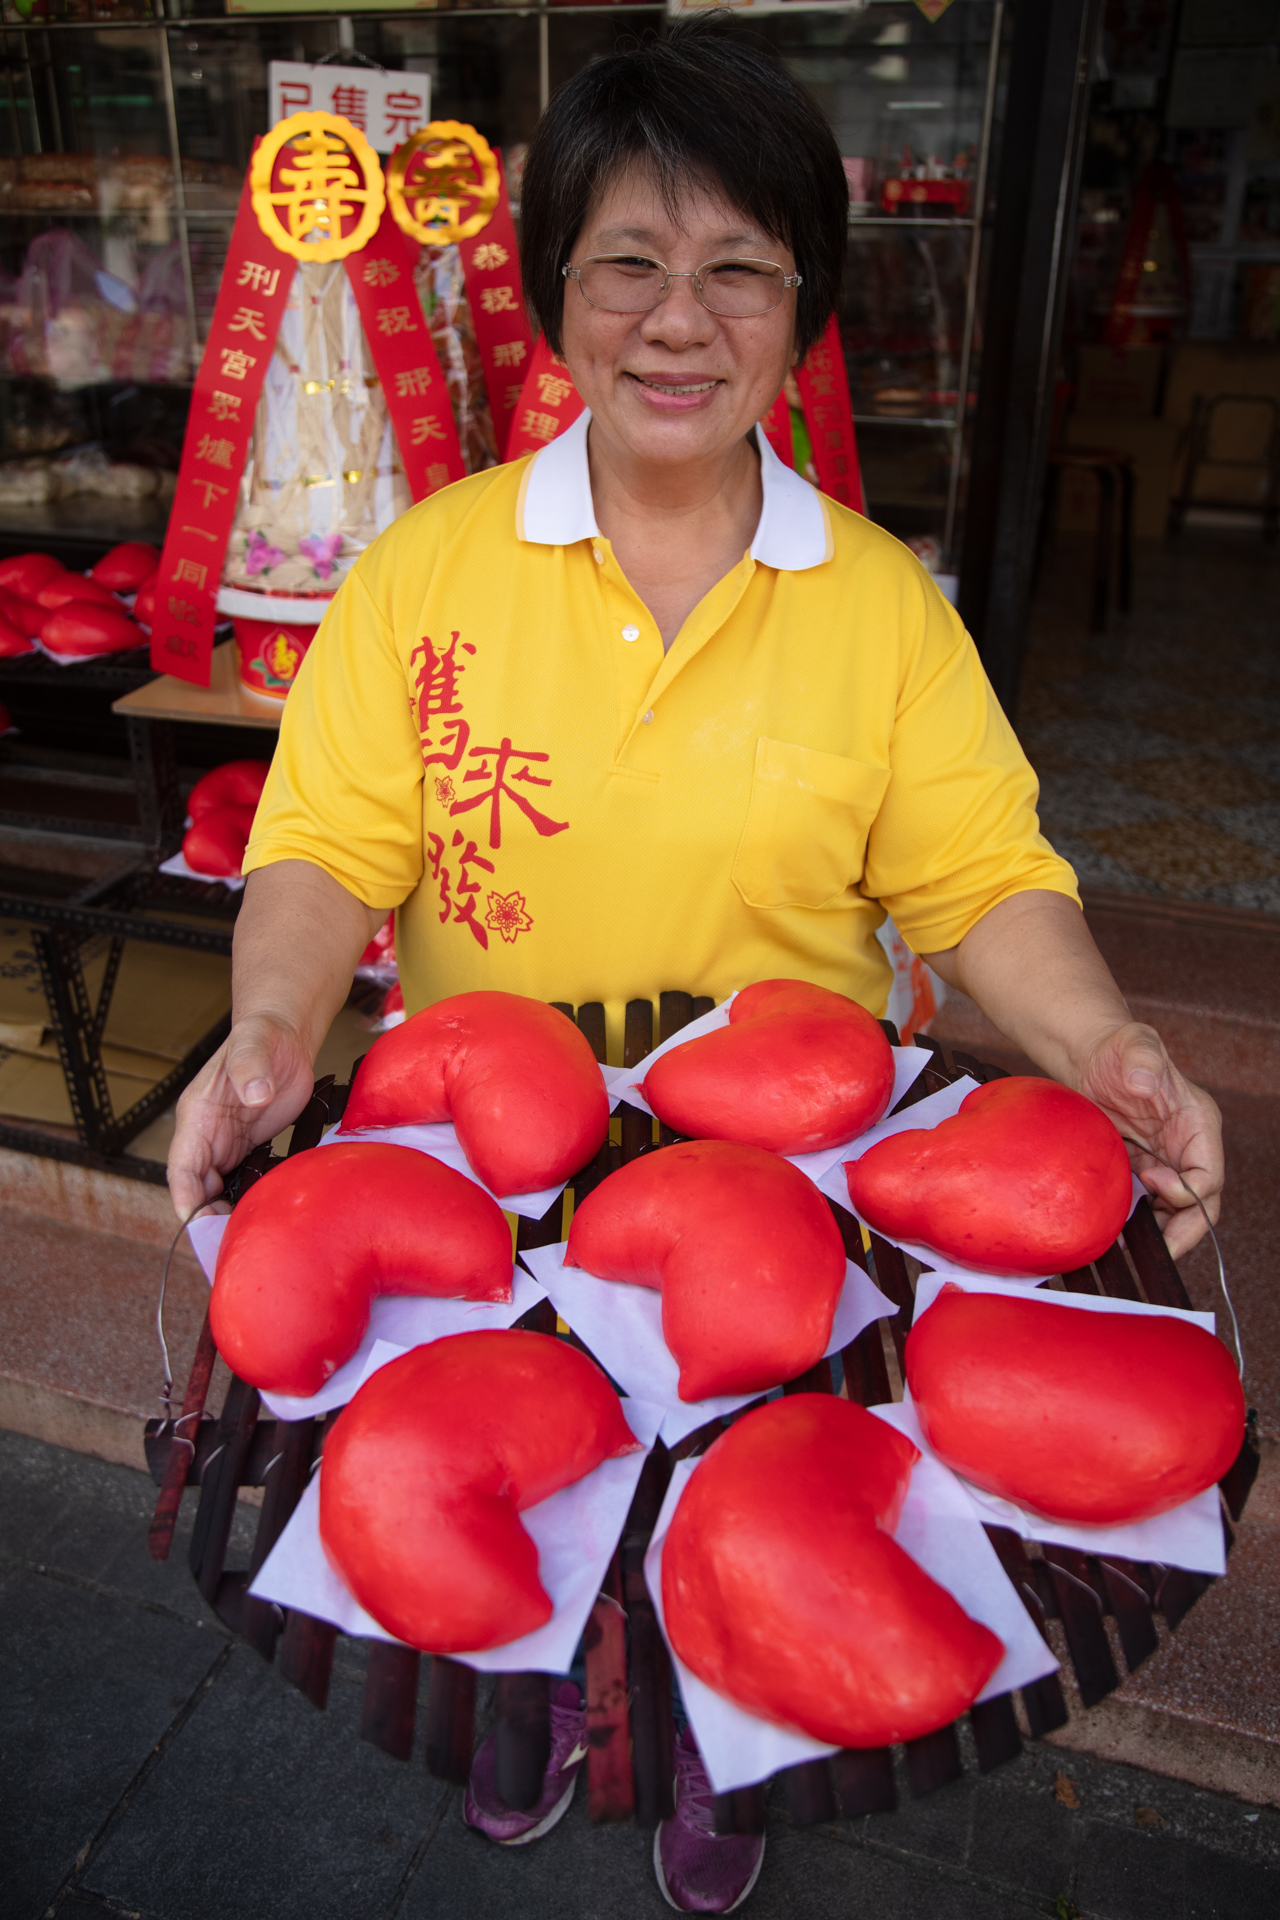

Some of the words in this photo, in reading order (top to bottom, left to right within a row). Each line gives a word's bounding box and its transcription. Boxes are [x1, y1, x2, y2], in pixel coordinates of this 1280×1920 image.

[279, 81, 423, 140] 已售完
[520, 354, 576, 458] 管理
